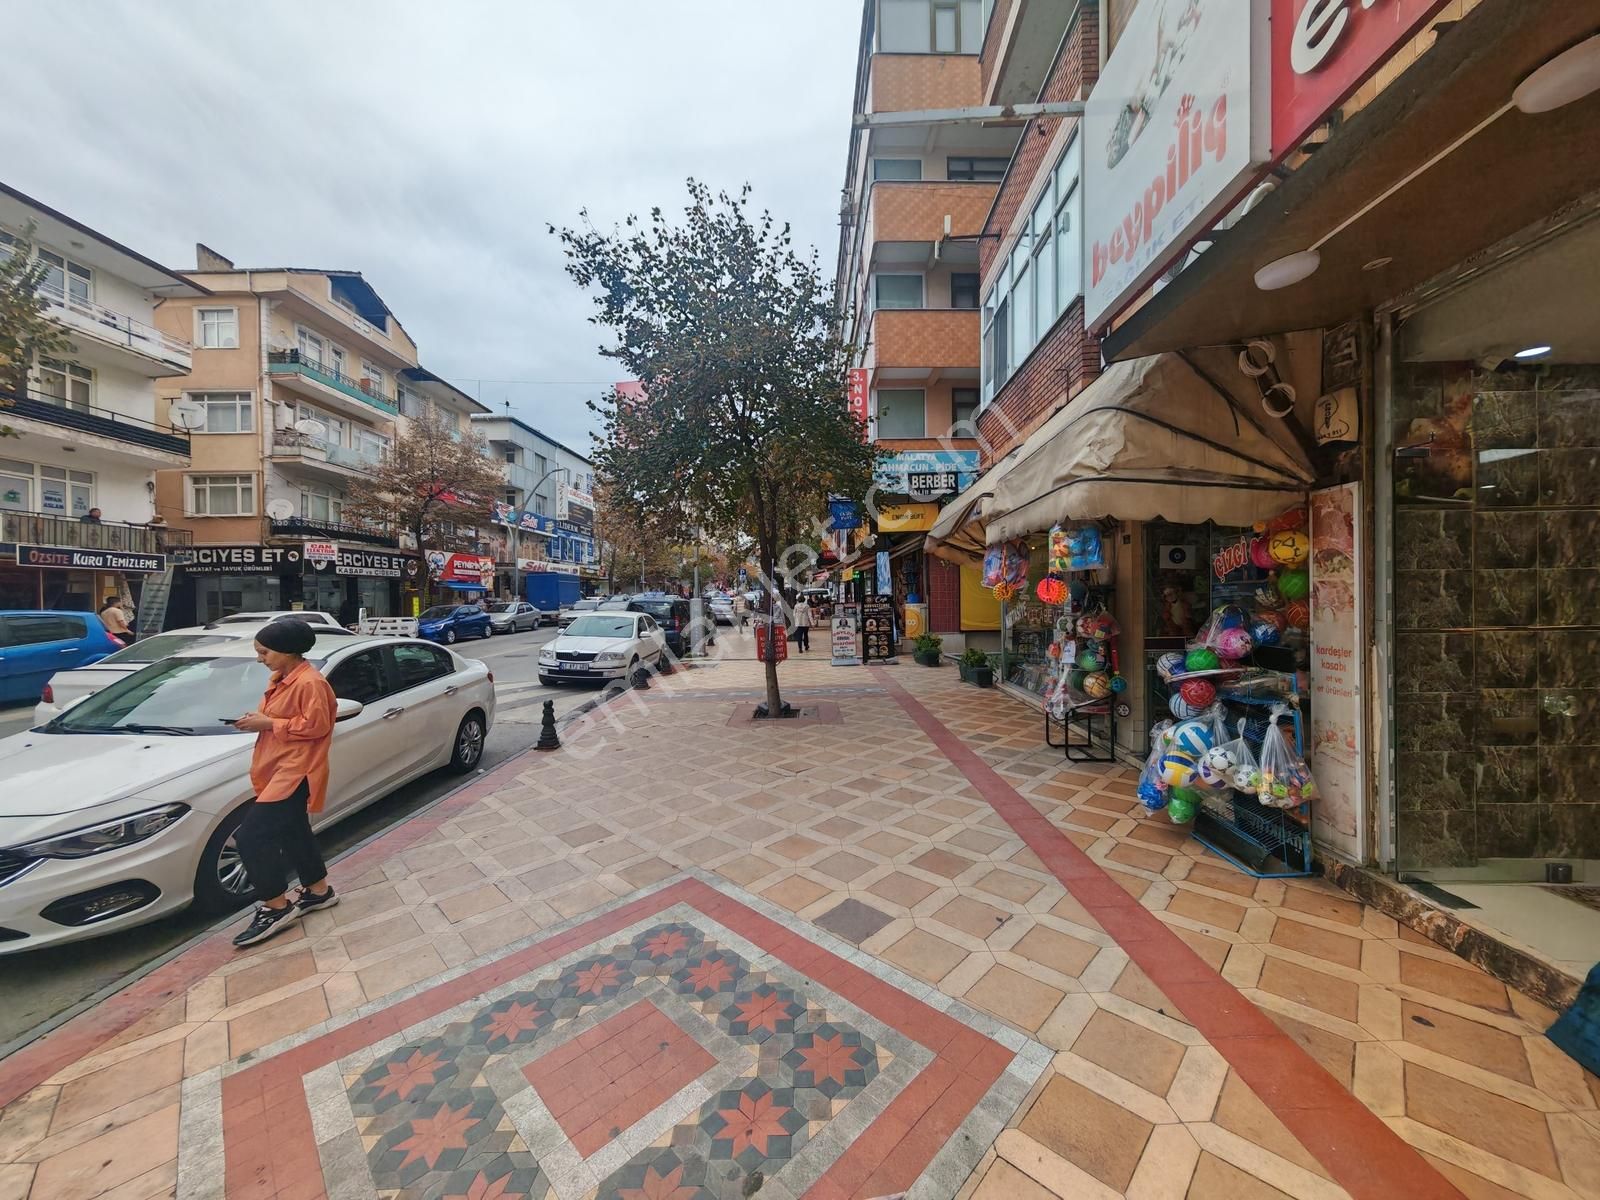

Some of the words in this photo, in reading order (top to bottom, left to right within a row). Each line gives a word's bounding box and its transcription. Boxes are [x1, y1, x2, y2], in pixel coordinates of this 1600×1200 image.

[911, 474, 956, 489] BERBER
[262, 548, 285, 563] ET
[392, 557, 405, 569] ET
[1315, 644, 1352, 659] kardeşler
